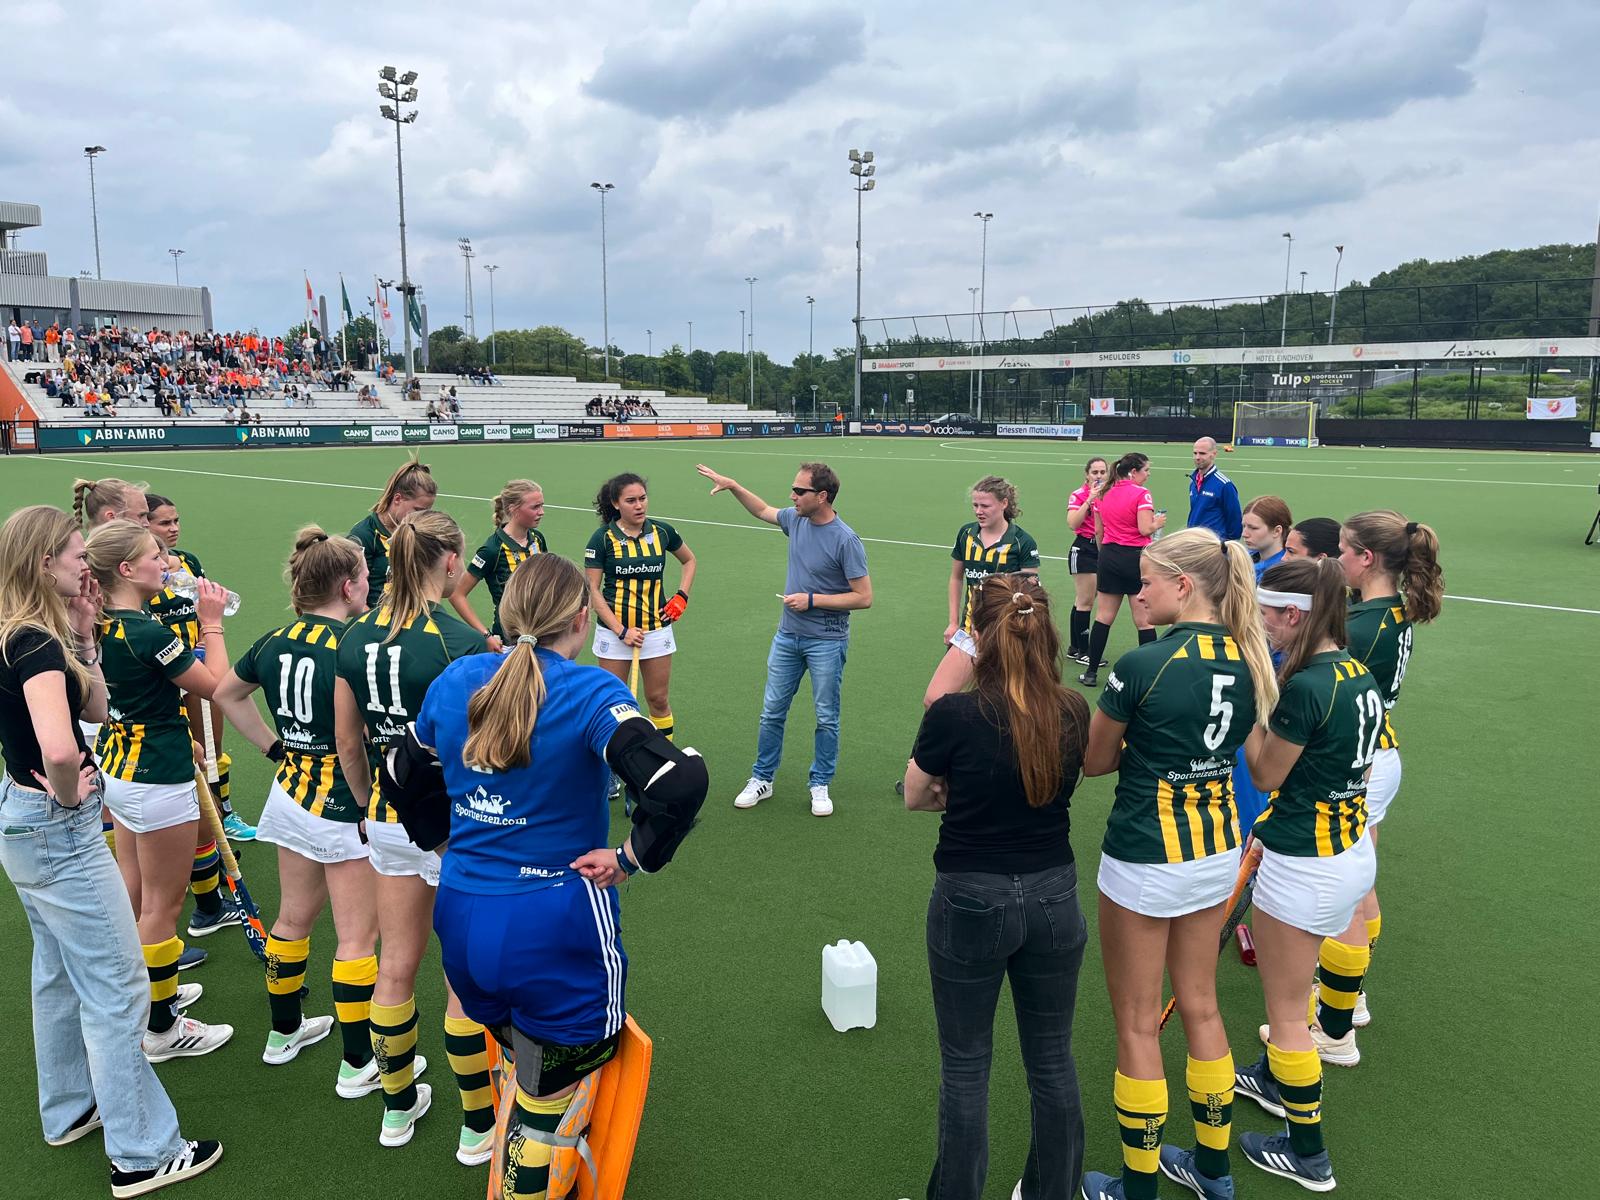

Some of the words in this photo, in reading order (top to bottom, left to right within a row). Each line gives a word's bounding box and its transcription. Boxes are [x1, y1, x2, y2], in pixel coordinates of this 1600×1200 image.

[1099, 353, 1141, 361] SMEULDERS
[1172, 352, 1191, 363] tio
[1256, 354, 1275, 362] HOTEL
[1277, 353, 1313, 361] EINDHOVEN
[1272, 373, 1302, 388] Tulp
[998, 426, 1027, 434] Driessen
[1029, 426, 1058, 436] Mobility
[1061, 426, 1081, 435] lease
[615, 563, 663, 575] Rabobank
[364, 642, 408, 717] 11
[277, 653, 315, 724] 10
[1203, 674, 1235, 751] 5
[1351, 689, 1383, 769] 12
[520, 866, 548, 876] OSAKA
